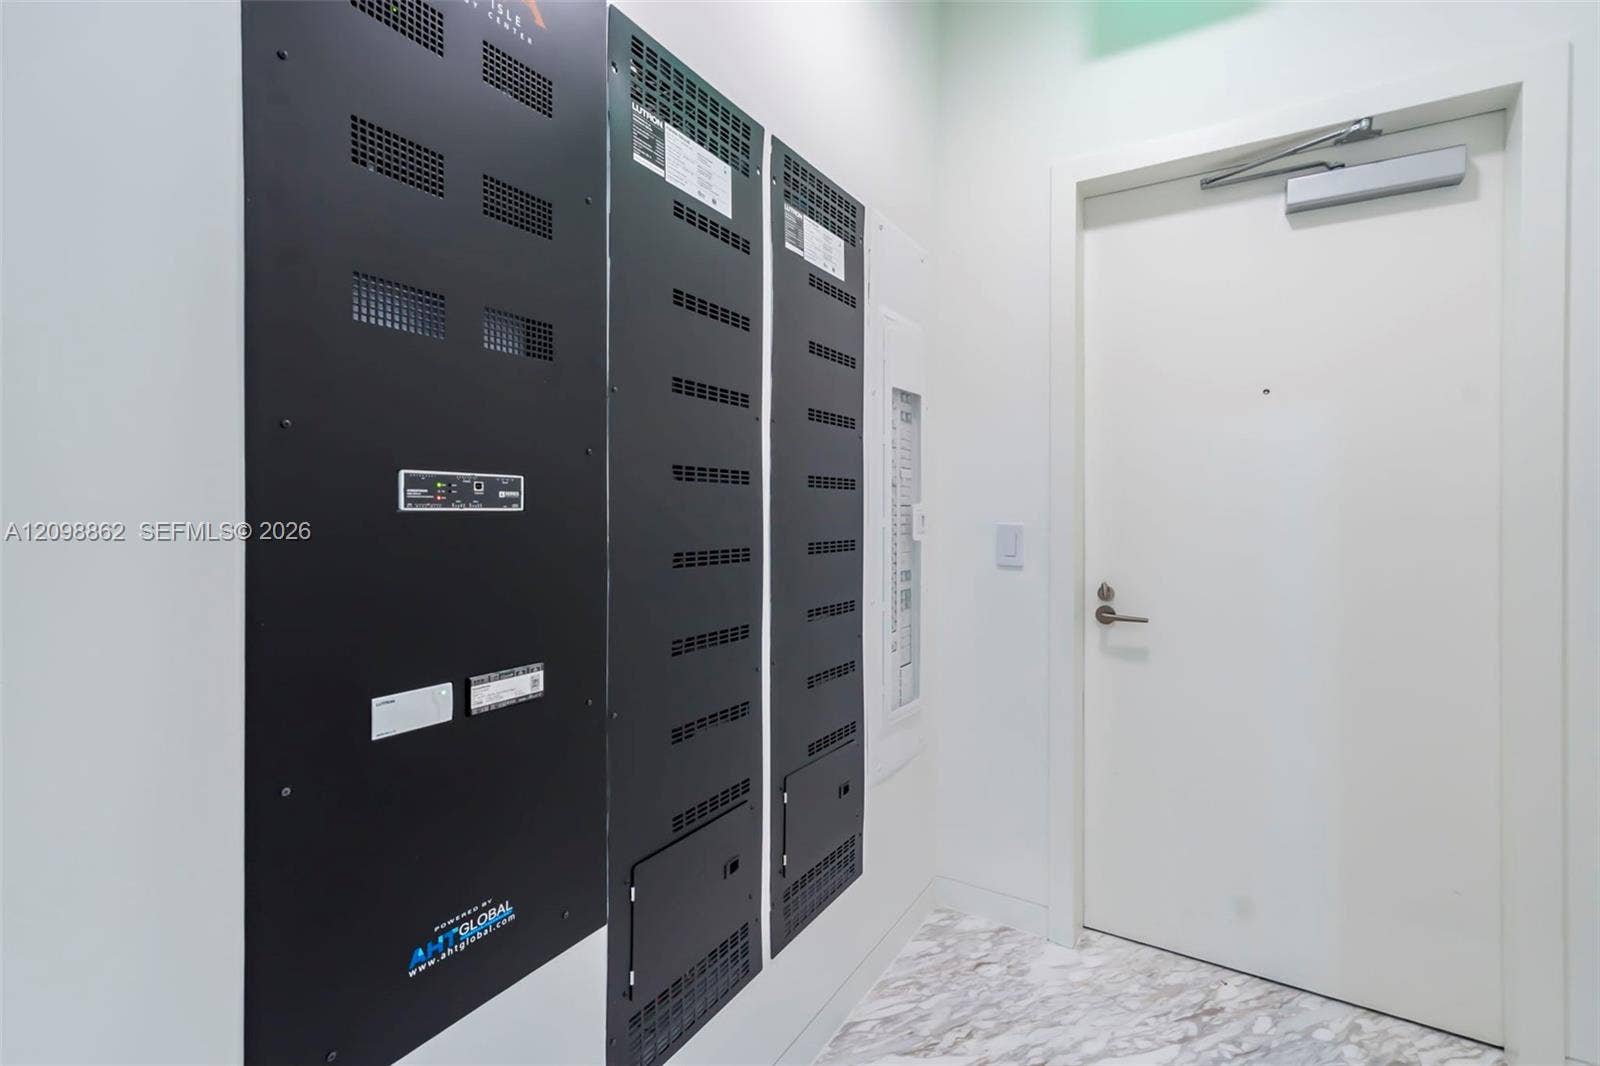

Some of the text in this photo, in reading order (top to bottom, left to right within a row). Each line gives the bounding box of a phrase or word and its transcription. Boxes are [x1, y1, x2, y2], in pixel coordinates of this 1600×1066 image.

[631, 101, 664, 129] LUTRON
[434, 898, 493, 932] POWERED BY
[408, 913, 516, 978] www.ahtglobal.com
